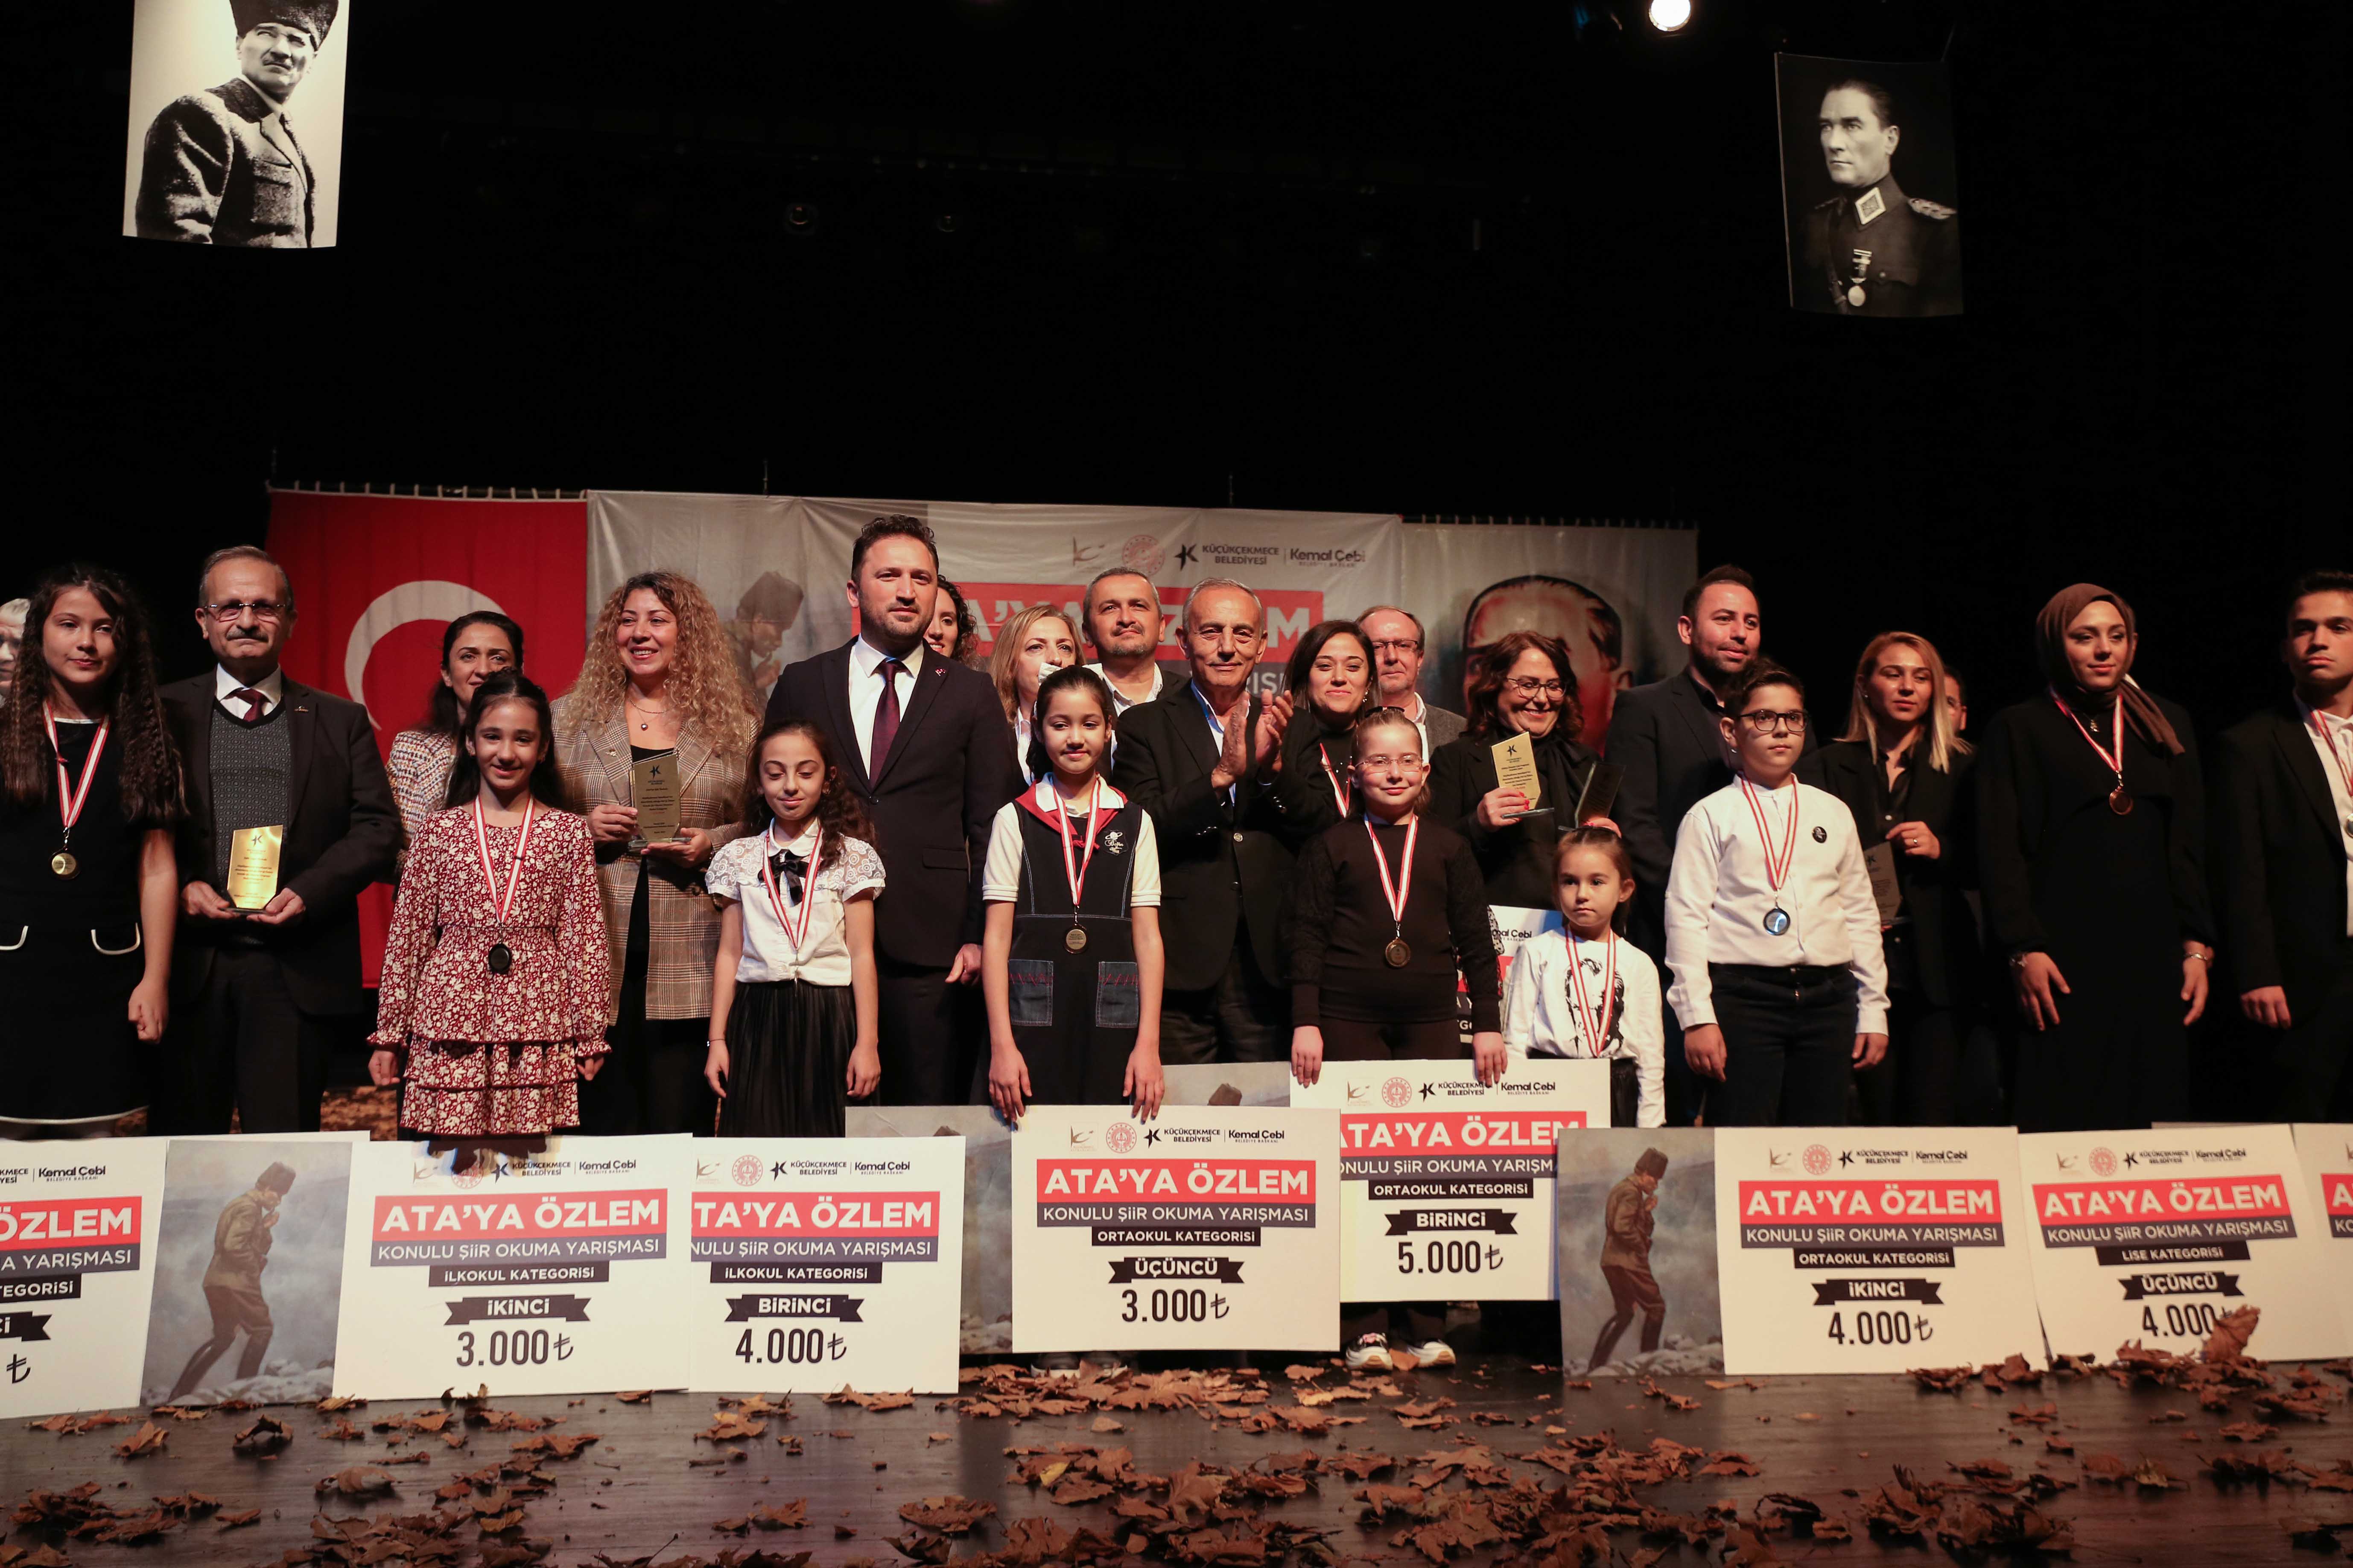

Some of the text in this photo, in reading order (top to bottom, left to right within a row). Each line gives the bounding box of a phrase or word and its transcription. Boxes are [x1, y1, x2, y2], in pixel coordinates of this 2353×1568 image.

[1202, 544, 1279, 554] KÜÇÜKÇEKMECE
[1290, 548, 1366, 562] Kemal Çebi
[1215, 556, 1267, 565] BELEDİYESİ
[1501, 1082, 1555, 1091] Kemal Çebi
[1229, 1130, 1284, 1139] Kemal Çebi
[1916, 1151, 1944, 1160] Kemal
[2196, 1150, 2223, 1158] Kemal
[512, 1161, 571, 1169] KÜÇÜKÇEKMECE
[579, 1160, 636, 1170] Kemal Çebi
[791, 1160, 847, 1169] KÜÇÜKÇEKMECE
[855, 1161, 910, 1171] Kemal Çebi
[1428, 1159, 1487, 1173] OKUMA
[1492, 1159, 1557, 1174] YARIŞM
[38, 1166, 106, 1178] Kemal Çebi
[522, 1168, 562, 1176] BELEDİYESİ
[1045, 1163, 1308, 1195] ATA'YA ÖZLEM
[1374, 1184, 1446, 1195] ORTAOKUL
[1746, 1183, 1994, 1215] ATA'YA ÖZLEM
[2044, 1182, 2282, 1218] ATA'YA ÖZLEM
[381, 1196, 659, 1232] ATA'YA ÖZLEM
[691, 1195, 932, 1228] TA'YA ÖZLEM
[1044, 1207, 1113, 1221] KONULU
[1151, 1207, 1214, 1221] OKUMA
[1219, 1207, 1308, 1224] YARIŞMASI
[0, 1205, 132, 1242] ÖZLEM
[1098, 1231, 1171, 1242] ORTAOKUL
[1747, 1228, 1813, 1242] KONULU
[1849, 1228, 1908, 1242] OKUMA
[1912, 1227, 1997, 1244] YARIŞMASI
[2048, 1228, 2111, 1243] KONULU
[2145, 1224, 2201, 1239] OKUMA
[2203, 1220, 2288, 1237] YARIŞMASI
[378, 1245, 453, 1260] KONULU
[495, 1242, 561, 1258] OKUMA
[566, 1238, 660, 1256] YARIŞMASI
[773, 1242, 836, 1256] OKUMA
[841, 1241, 931, 1258] YARIŞMASI
[0, 1249, 131, 1271] A YARIŞMASI
[1799, 1253, 1870, 1264] ORTAOKUL
[1135, 1258, 1218, 1277] ÜÇÜNCÜ
[2141, 1272, 2218, 1294] ÜÇÜNCÜ
